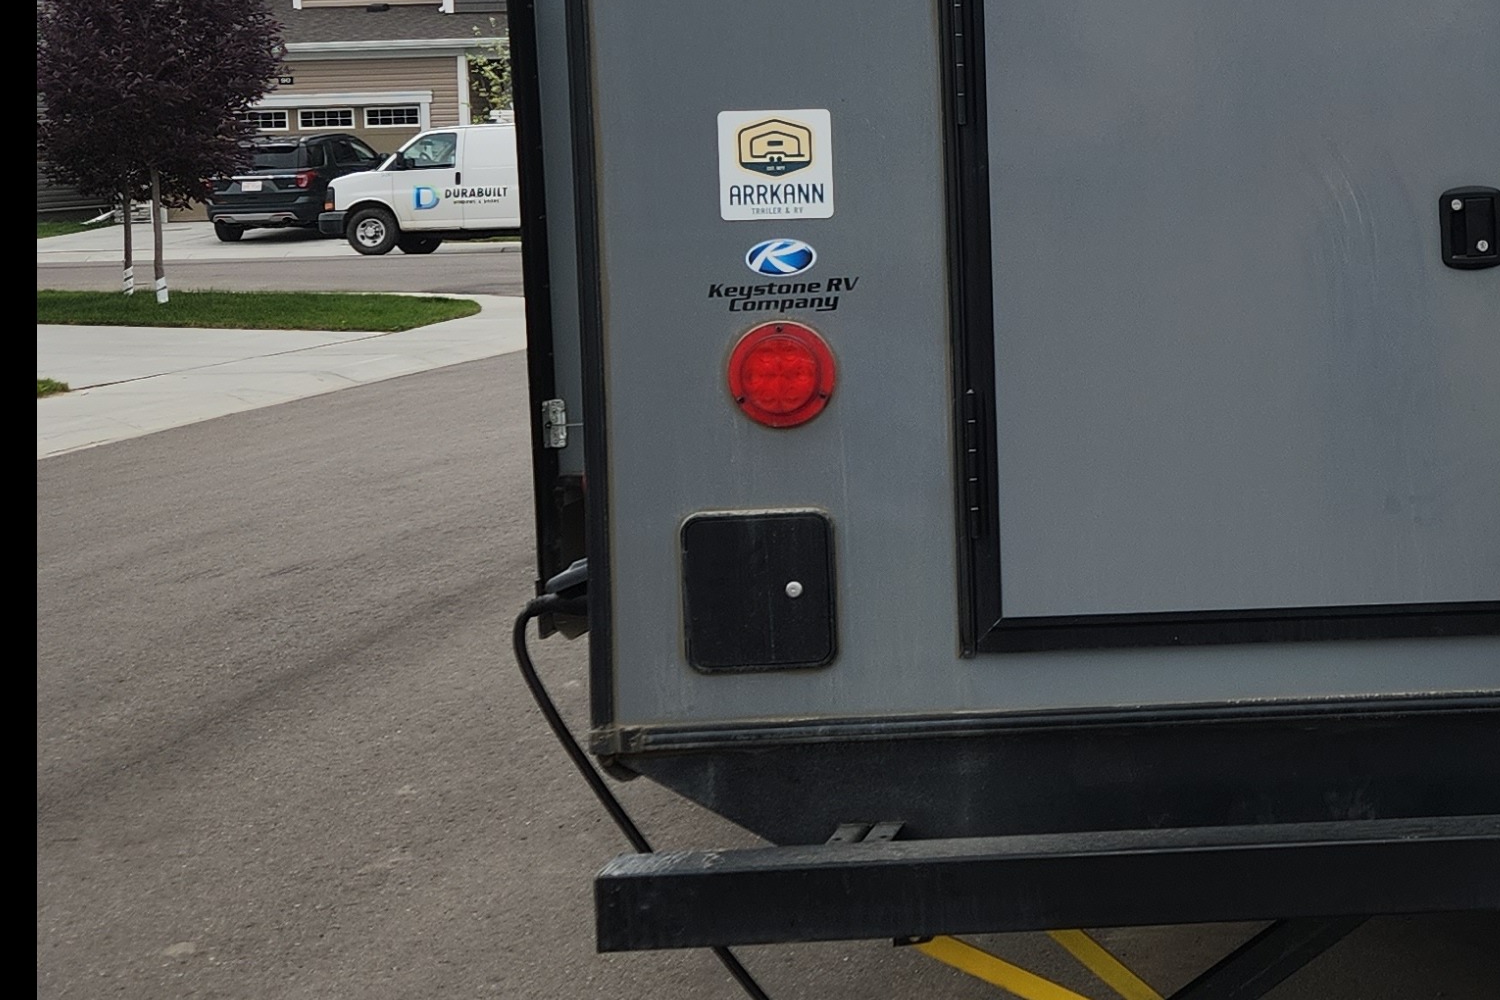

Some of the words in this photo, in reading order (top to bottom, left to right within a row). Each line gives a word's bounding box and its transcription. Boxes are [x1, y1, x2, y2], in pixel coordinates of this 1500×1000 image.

[445, 187, 508, 199] DURABUILT
[730, 183, 824, 205] ARRKANN
[752, 207, 782, 215] TRAILER
[785, 206, 791, 214] &
[794, 206, 804, 214] RV
[708, 280, 821, 301] Keystone
[826, 276, 860, 292] RV
[728, 296, 840, 313] Company
